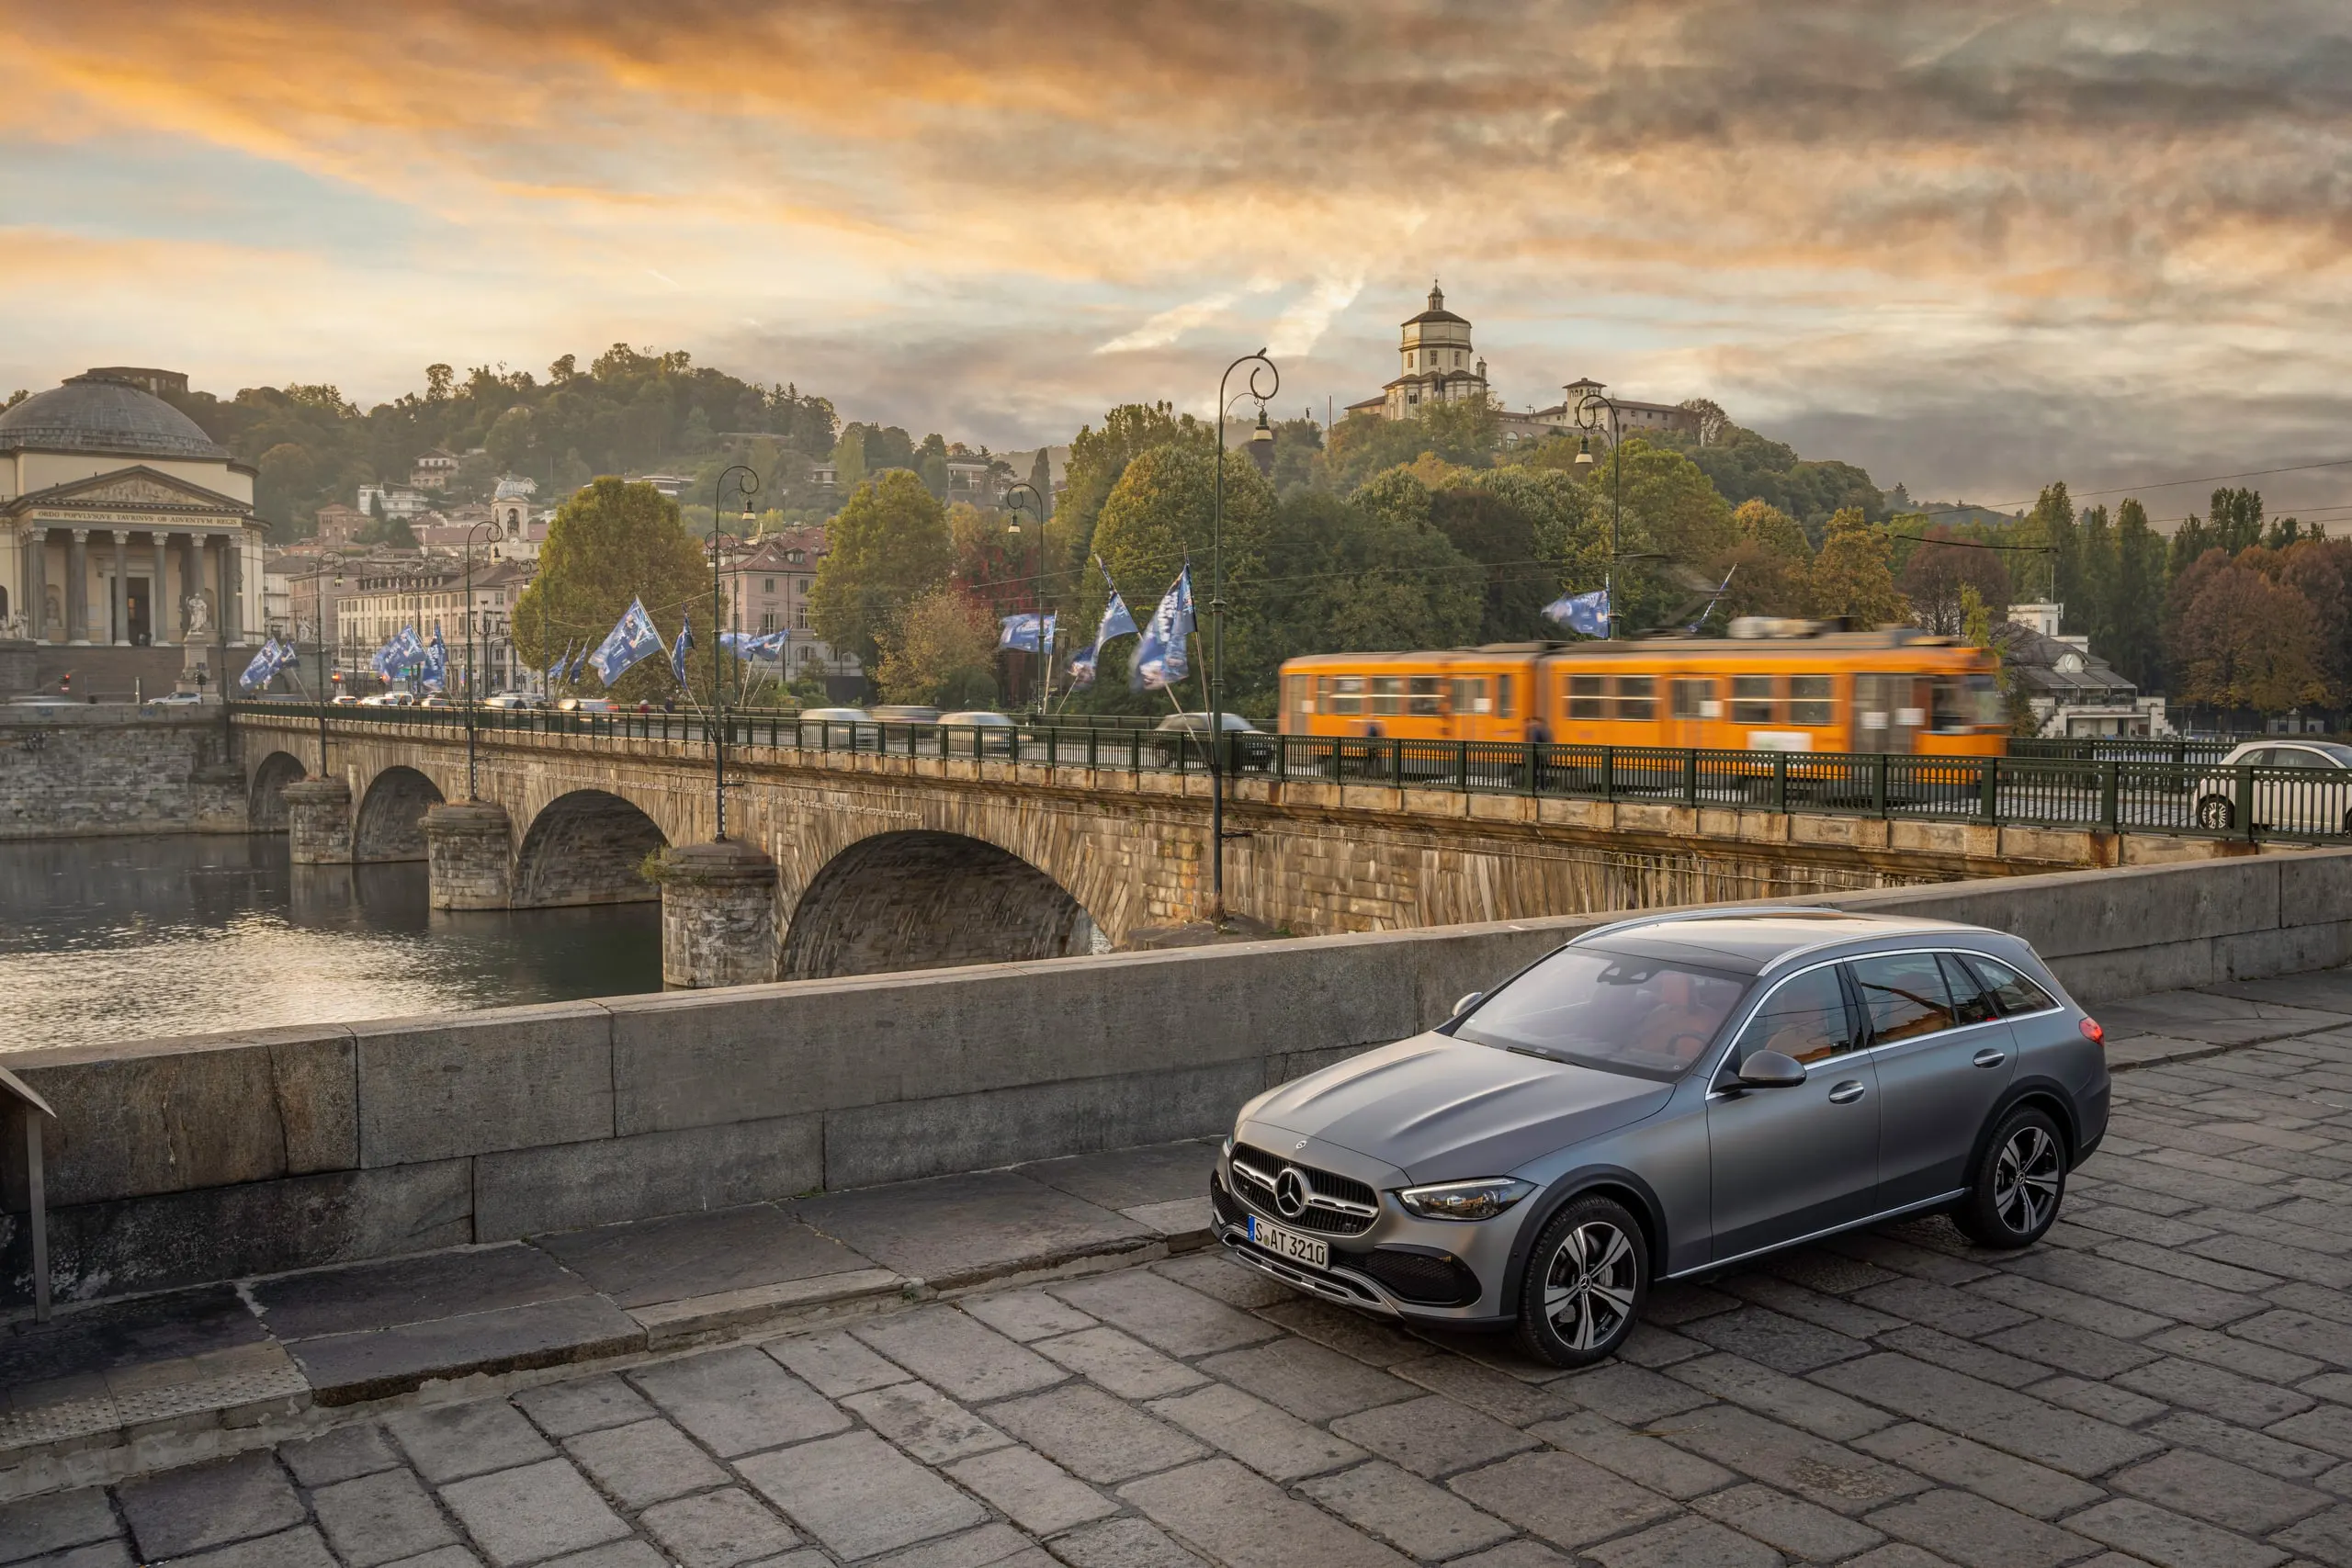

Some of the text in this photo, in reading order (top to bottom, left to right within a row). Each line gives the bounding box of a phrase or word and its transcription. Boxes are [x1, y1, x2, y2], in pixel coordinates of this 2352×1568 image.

[170, 516, 212, 525] ADVENTVM
[1255, 1223, 1325, 1265] S AT 3210
